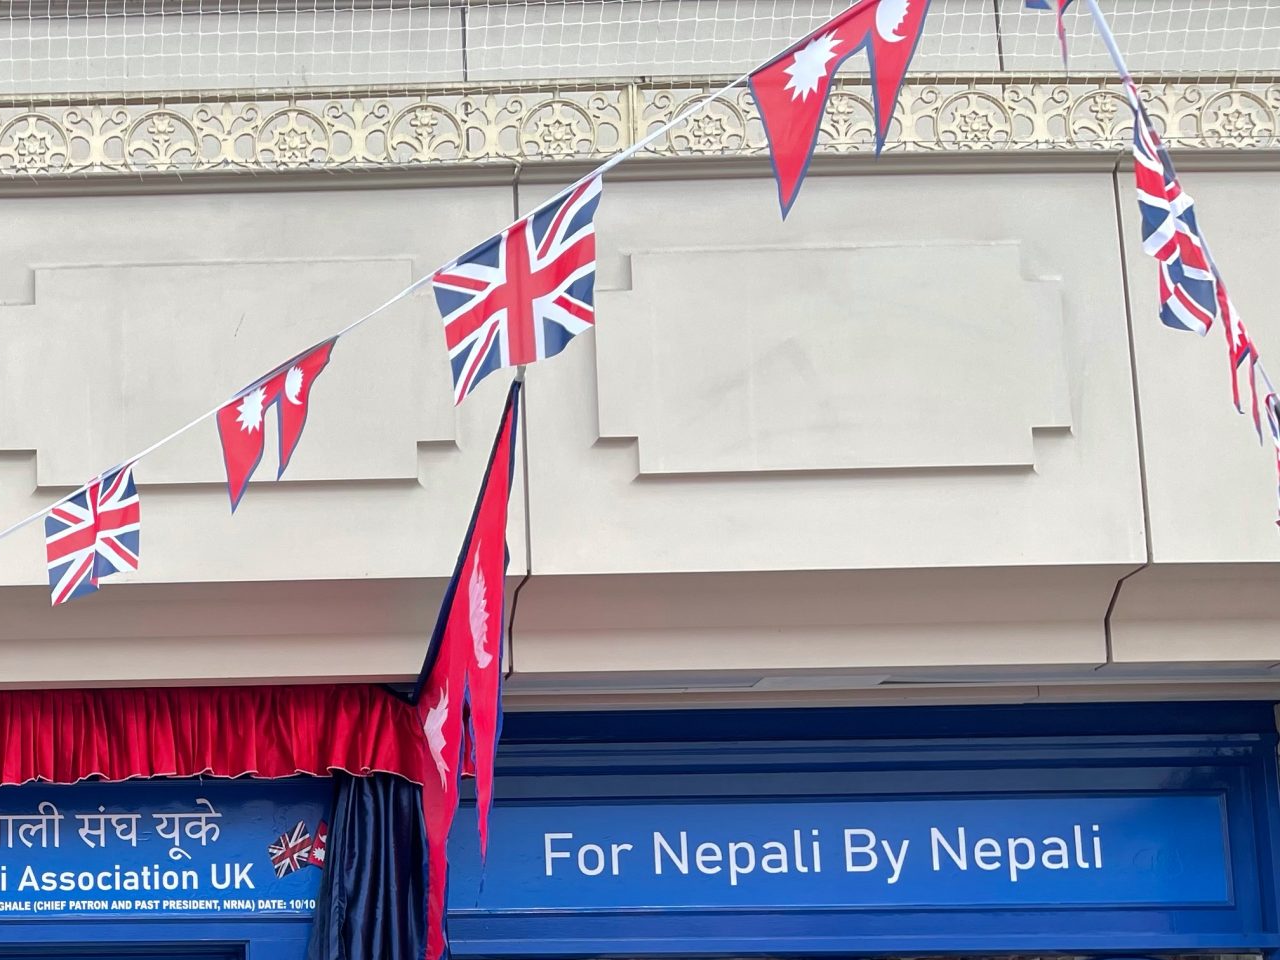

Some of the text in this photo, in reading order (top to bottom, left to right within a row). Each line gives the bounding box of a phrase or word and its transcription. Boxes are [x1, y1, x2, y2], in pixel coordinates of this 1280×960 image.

[75, 805, 142, 849] संघ
[152, 798, 223, 861] यूके
[17, 863, 200, 892] Association
[210, 862, 256, 890] UK
[544, 824, 1103, 886] For Nepali By Nepali
[33, 900, 67, 913] (CHIEF
[69, 900, 108, 910] PATRON
[111, 900, 132, 910] AND
[134, 900, 161, 910] PAST
[162, 899, 221, 912] PRESIDENT,
[223, 899, 256, 912] NRNA)
[258, 899, 287, 910] DATE:
